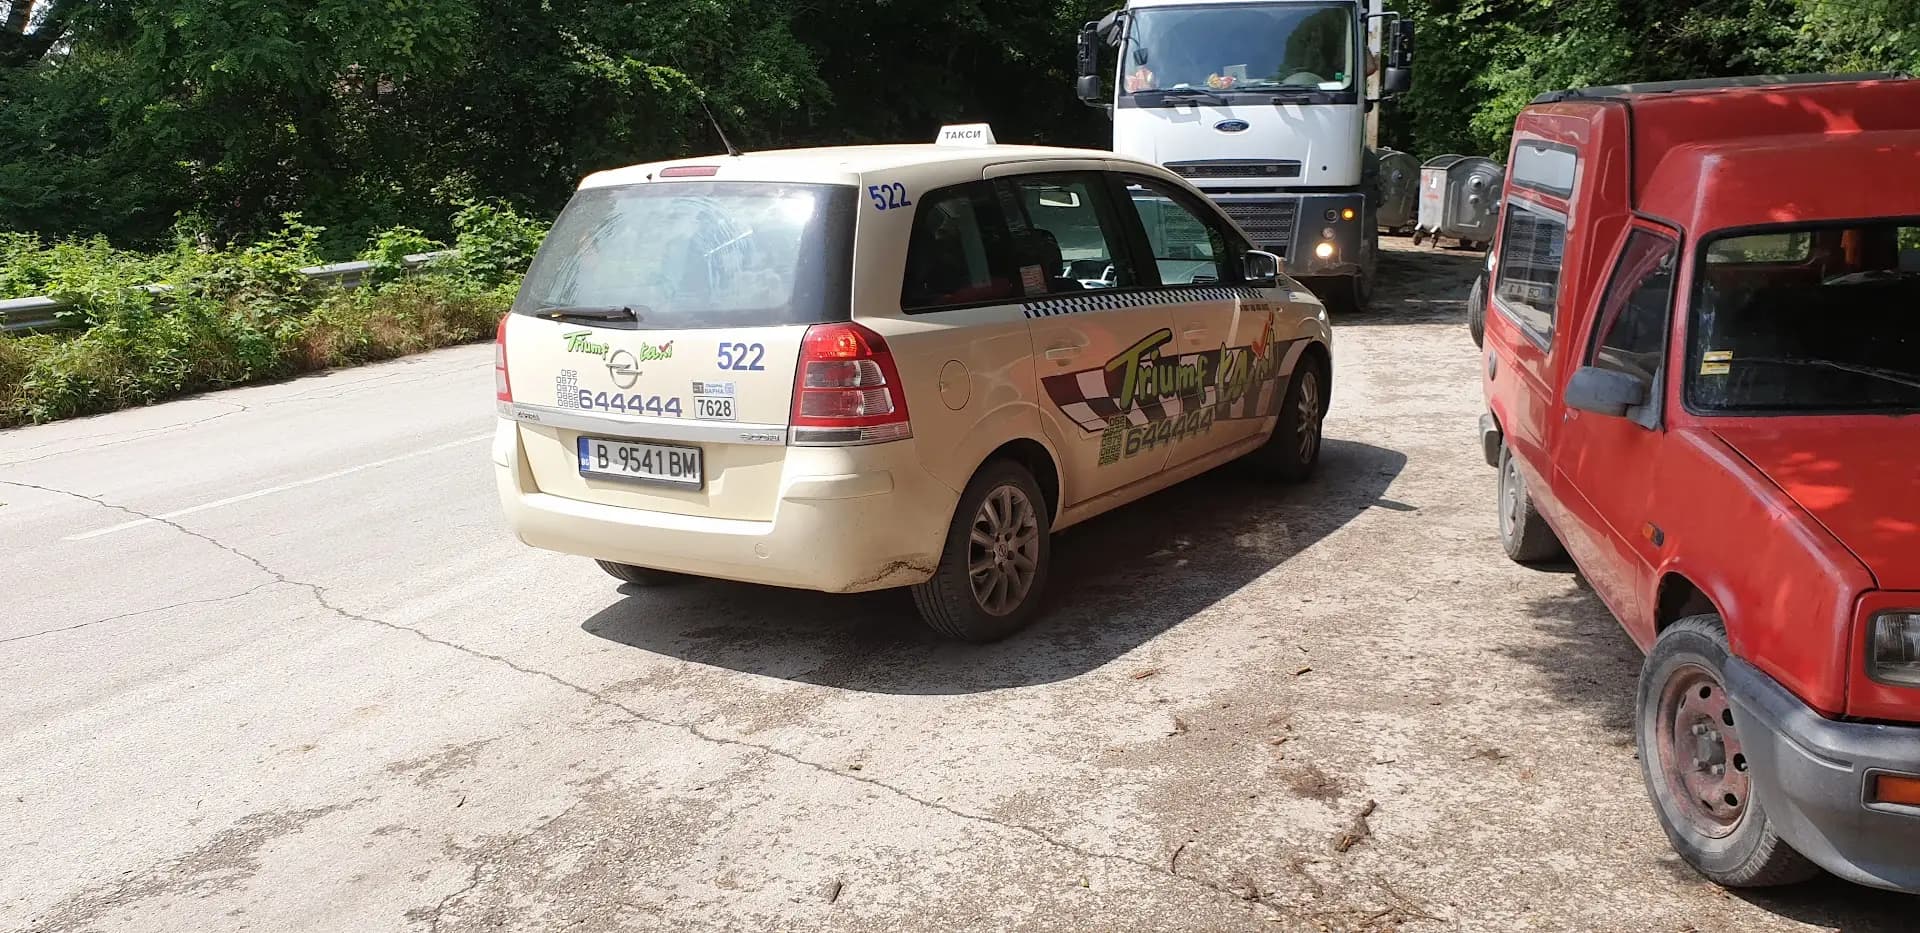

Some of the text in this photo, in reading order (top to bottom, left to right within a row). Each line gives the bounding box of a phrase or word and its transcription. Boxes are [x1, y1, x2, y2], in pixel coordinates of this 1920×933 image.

[944, 130, 981, 140] ТАКСИ
[868, 182, 912, 211] 522
[563, 330, 609, 361] Triumf
[716, 342, 765, 371] 522
[560, 369, 578, 378] 052
[1103, 327, 1208, 410] Triumf
[579, 389, 683, 417] 644444
[697, 399, 731, 417] 7628
[1125, 406, 1213, 456] 644444
